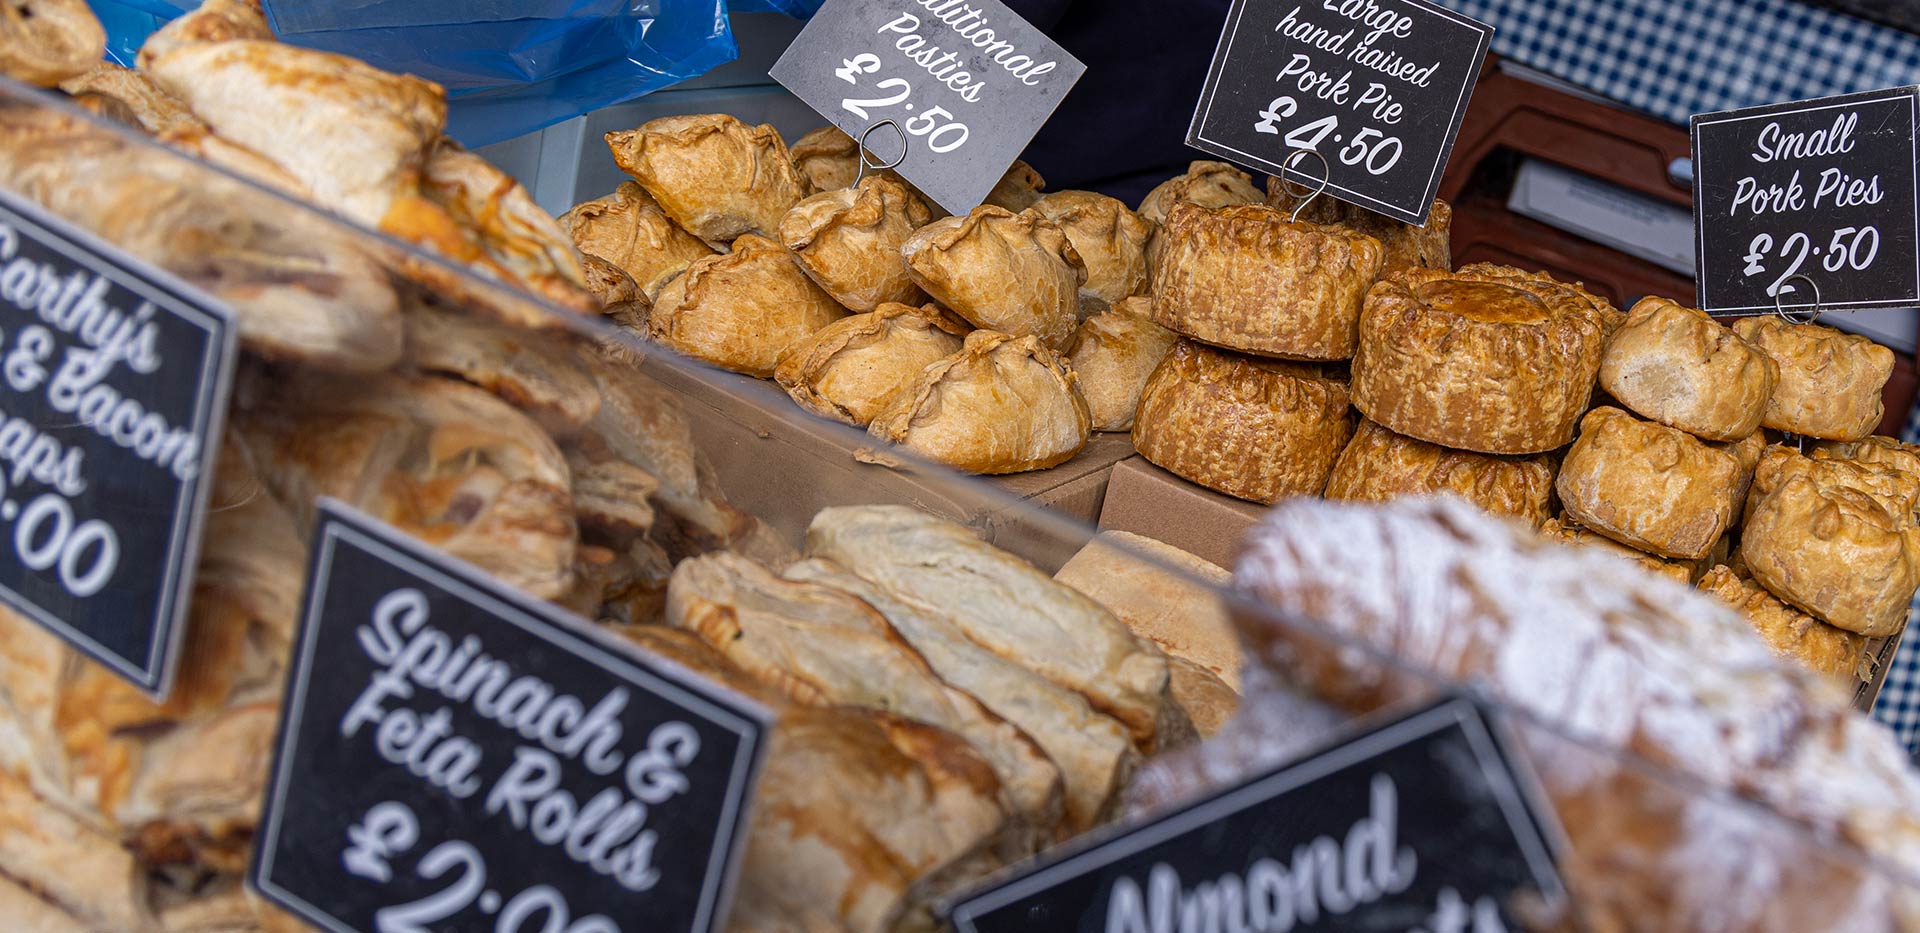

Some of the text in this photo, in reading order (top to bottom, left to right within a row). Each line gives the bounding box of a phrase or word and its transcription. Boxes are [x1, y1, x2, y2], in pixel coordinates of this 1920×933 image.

[877, 11, 986, 103] Pasties
[916, 0, 1057, 86] ditional
[1275, 7, 1440, 88] hand raised
[835, 53, 970, 153] £2.50
[1276, 53, 1403, 124] Pork Pie
[1254, 95, 1403, 175] £4.50
[1751, 112, 1858, 163] Small
[1730, 169, 1806, 217] Pork
[1813, 167, 1884, 209] Pies
[1742, 225, 1880, 298] £2.50
[3, 323, 200, 482] & Bacon
[0, 408, 88, 497] aps
[0, 465, 120, 597] .00
[356, 587, 700, 804] Spinach &
[340, 668, 662, 892] Feta Rolls
[341, 801, 622, 933] £2.0
[1104, 772, 1418, 933] Almond
